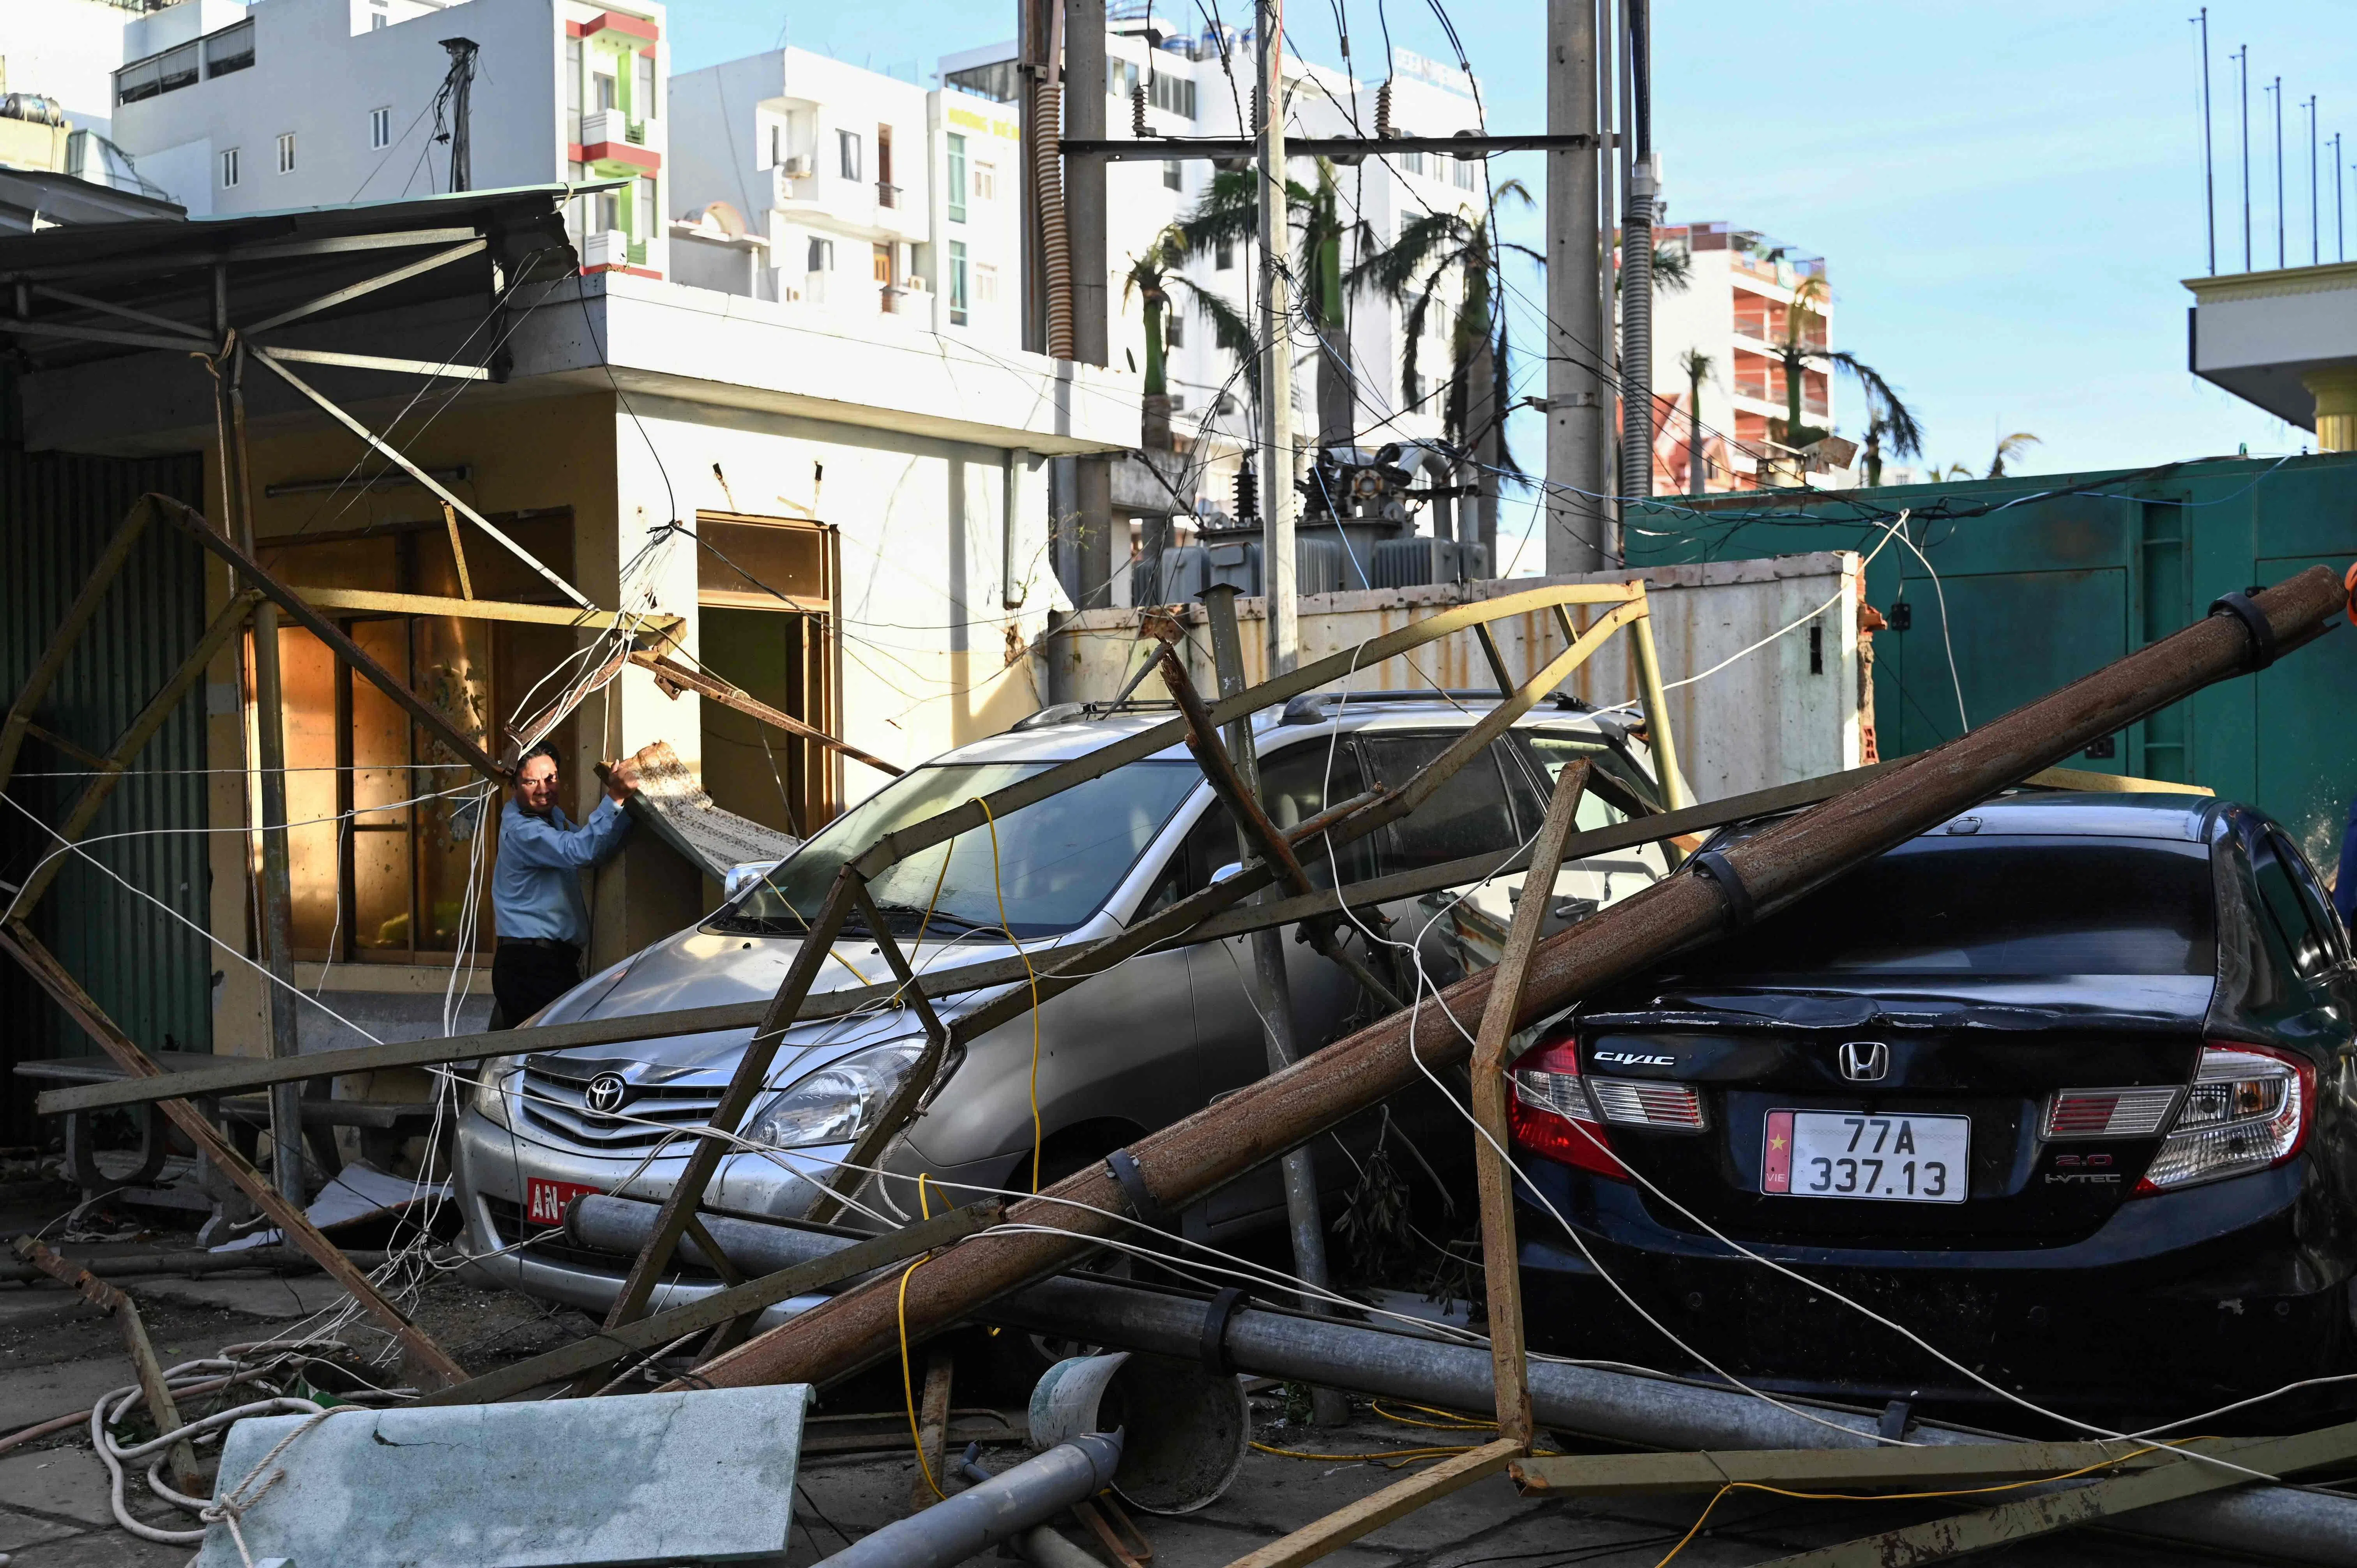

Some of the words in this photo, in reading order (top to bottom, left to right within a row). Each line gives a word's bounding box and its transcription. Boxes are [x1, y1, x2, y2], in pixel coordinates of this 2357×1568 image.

[1594, 1051, 1675, 1065] CIVIC
[1844, 1118, 1915, 1155] 77A
[2056, 1154, 2113, 1166] 2.0
[1766, 1173, 1785, 1182] VIE
[1809, 1157, 1946, 1195] 337.13
